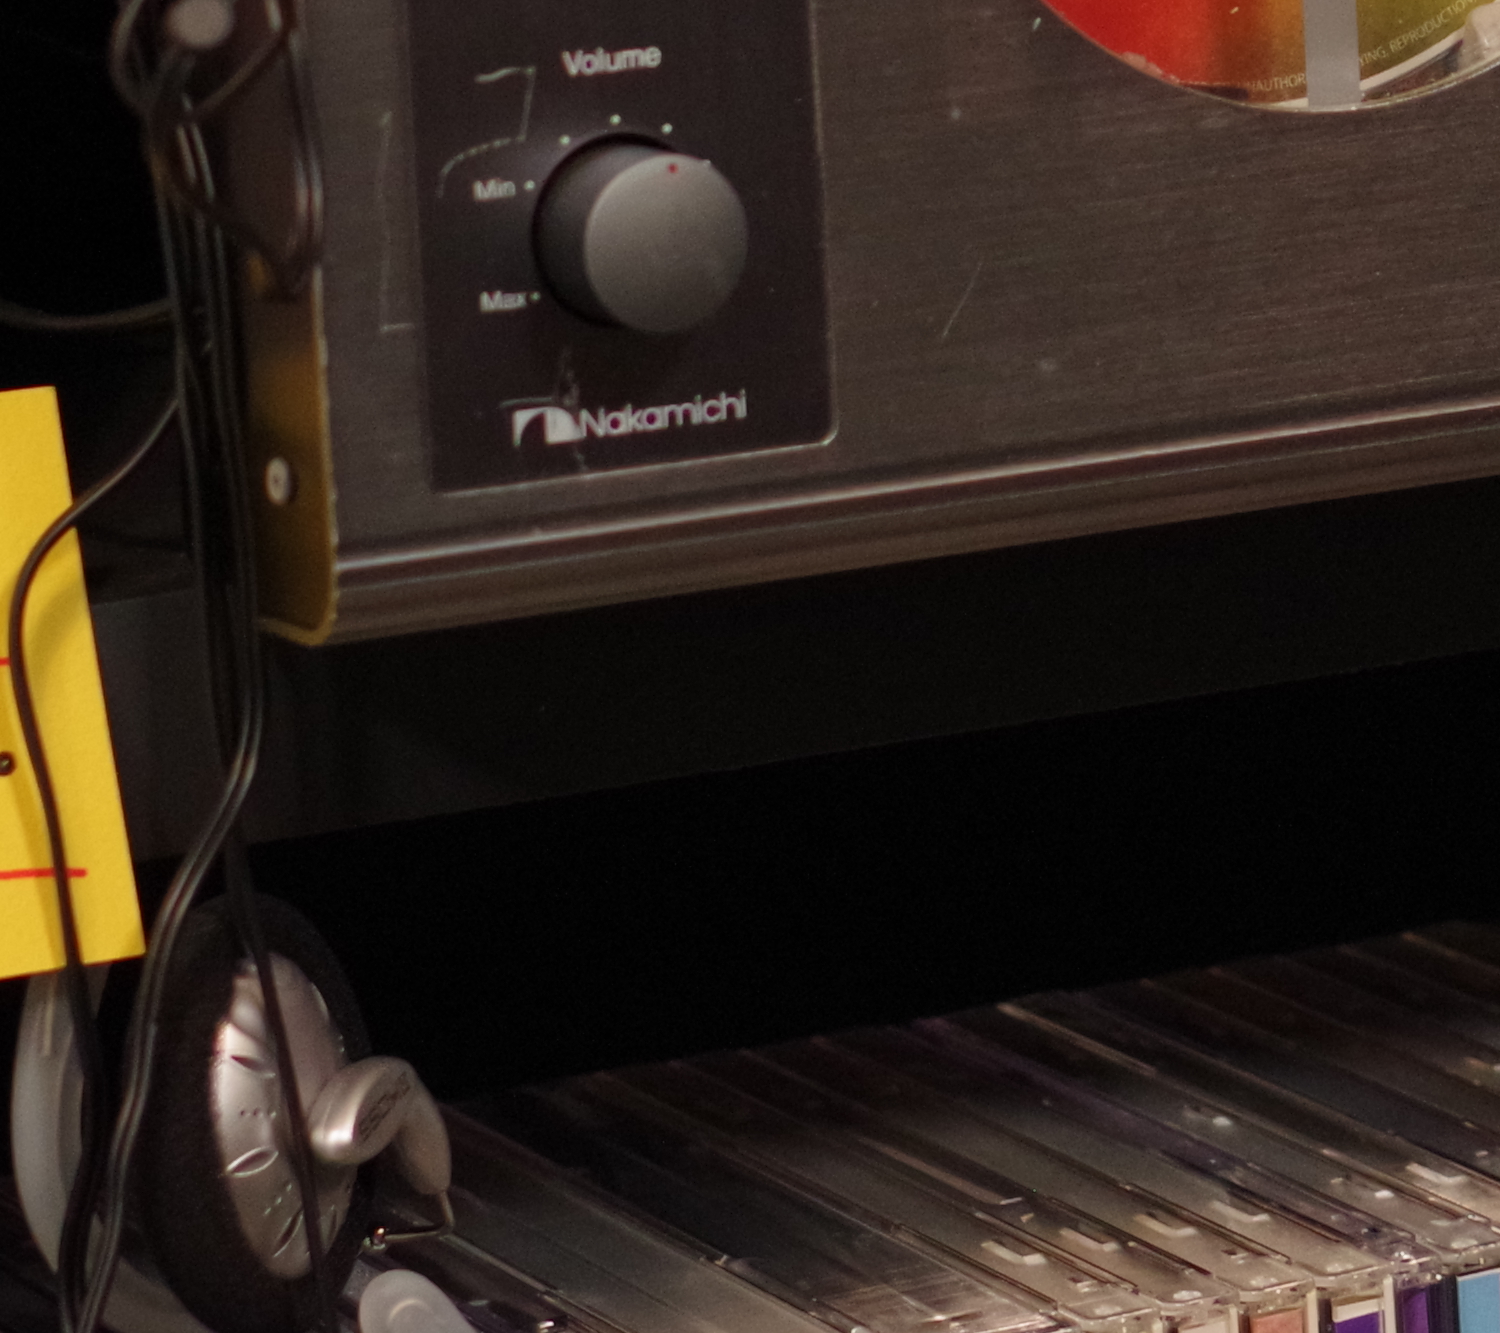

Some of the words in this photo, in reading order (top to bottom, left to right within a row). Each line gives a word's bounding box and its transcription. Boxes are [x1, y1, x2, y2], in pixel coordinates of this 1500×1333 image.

[561, 45, 662, 77] Volume
[473, 178, 517, 201] Min
[479, 291, 529, 313] Max
[580, 389, 748, 438] Nakamichi
